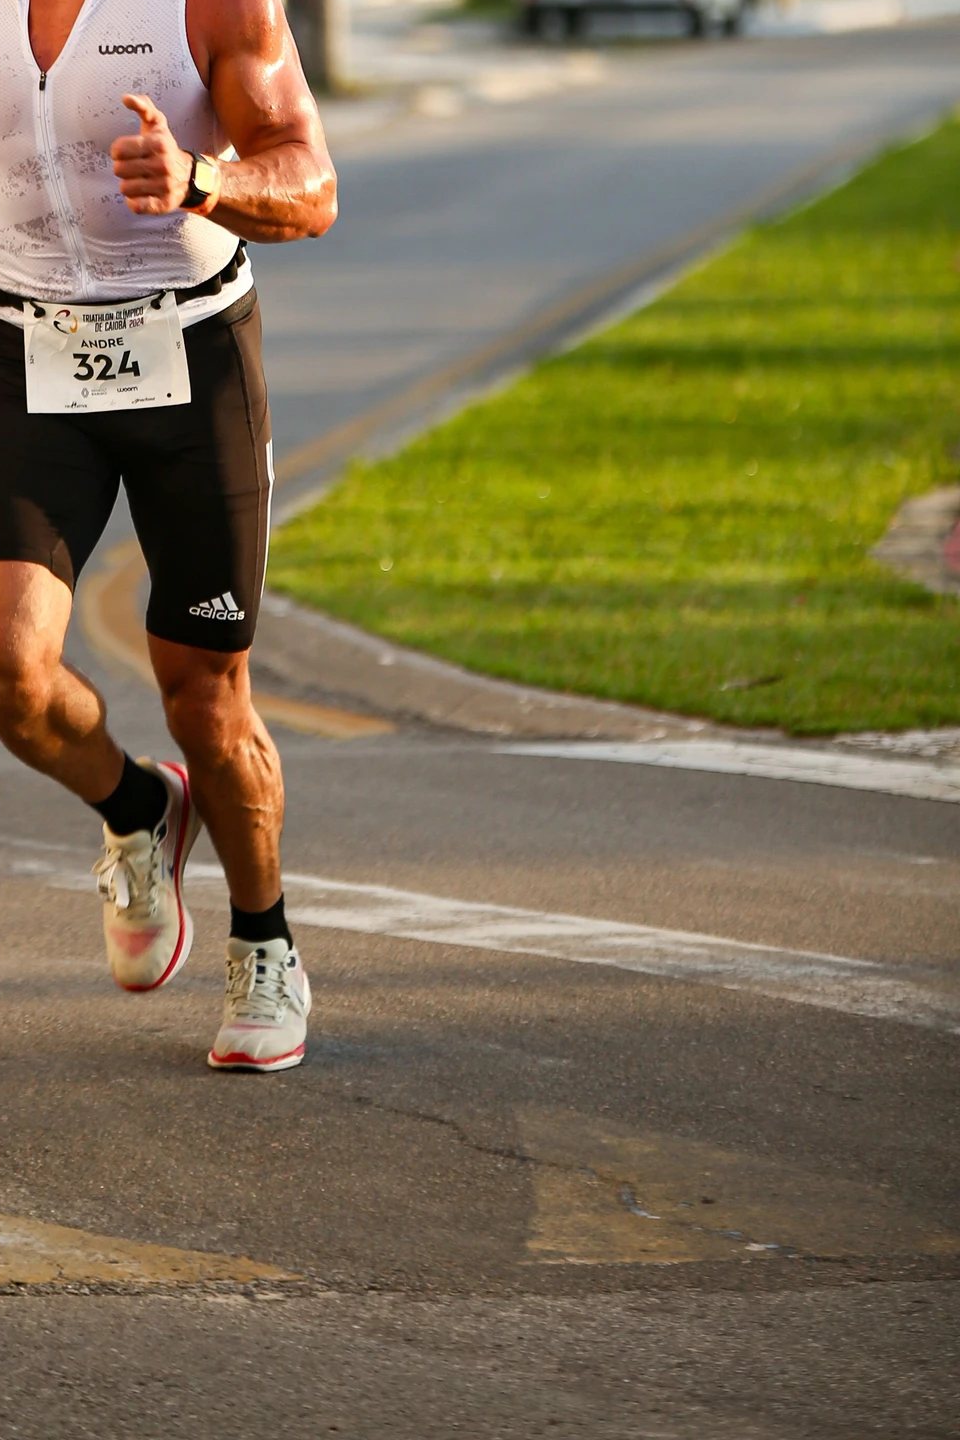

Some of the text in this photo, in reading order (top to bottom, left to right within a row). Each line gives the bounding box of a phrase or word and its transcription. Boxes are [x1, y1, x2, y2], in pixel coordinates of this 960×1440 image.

[98, 41, 153, 55] woom
[82, 312, 114, 323] TRIATHLON
[94, 322, 102, 333] DE
[128, 317, 144, 329] 2024
[80, 336, 124, 350] ANDRE
[72, 349, 141, 381] 324
[188, 606, 245, 621] adidas
